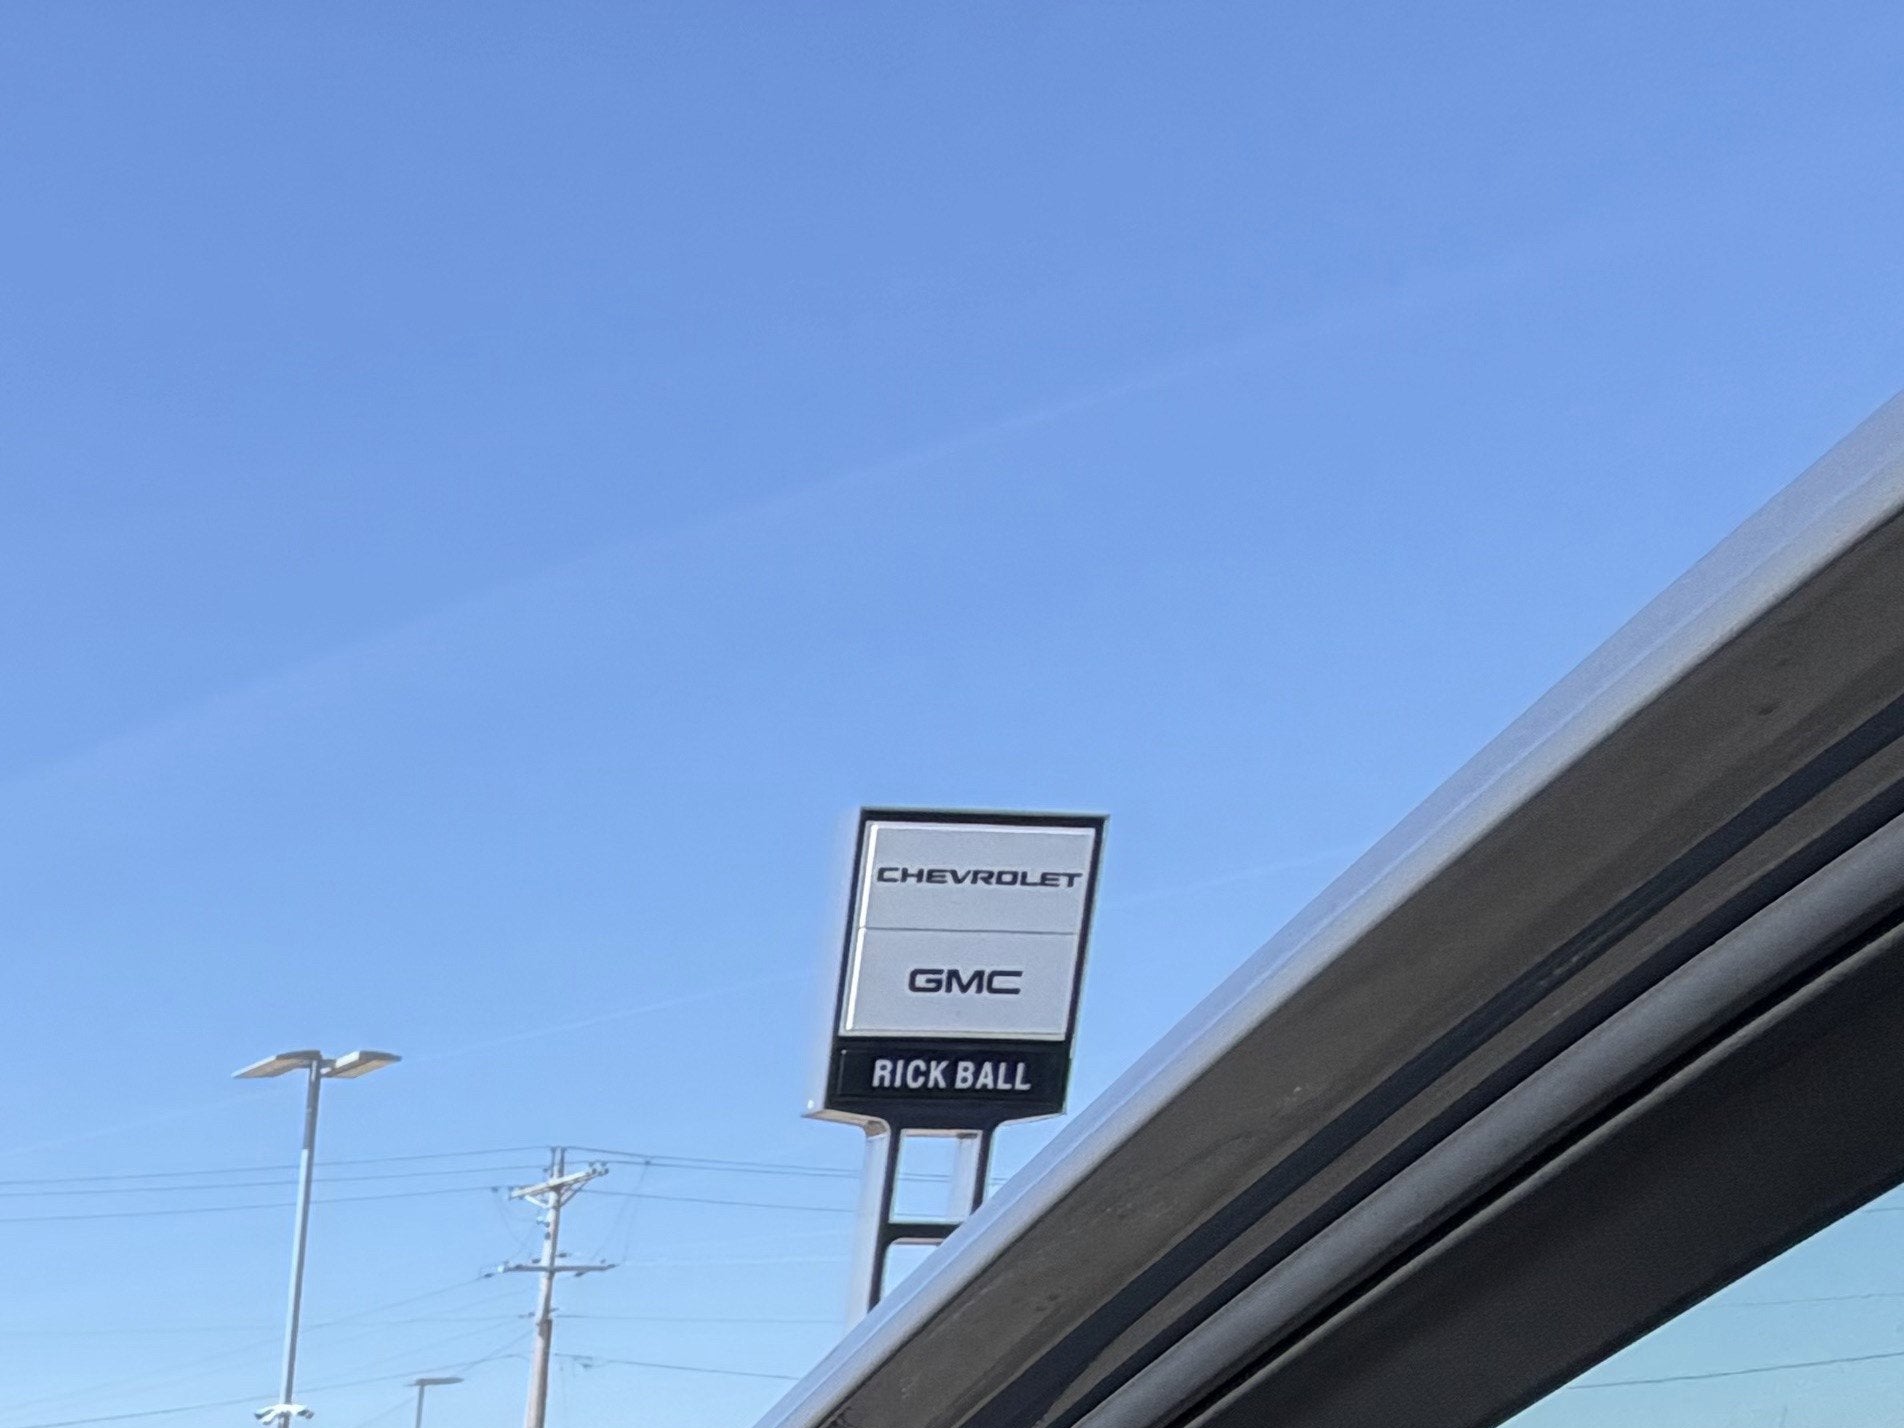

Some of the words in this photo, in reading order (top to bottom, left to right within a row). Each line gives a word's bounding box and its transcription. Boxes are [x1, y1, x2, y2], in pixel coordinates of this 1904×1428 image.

[876, 866, 1083, 889] CHEVROLET
[908, 968, 1023, 995] GMC
[872, 1058, 948, 1089] RICK
[954, 1060, 1032, 1091] BALL
